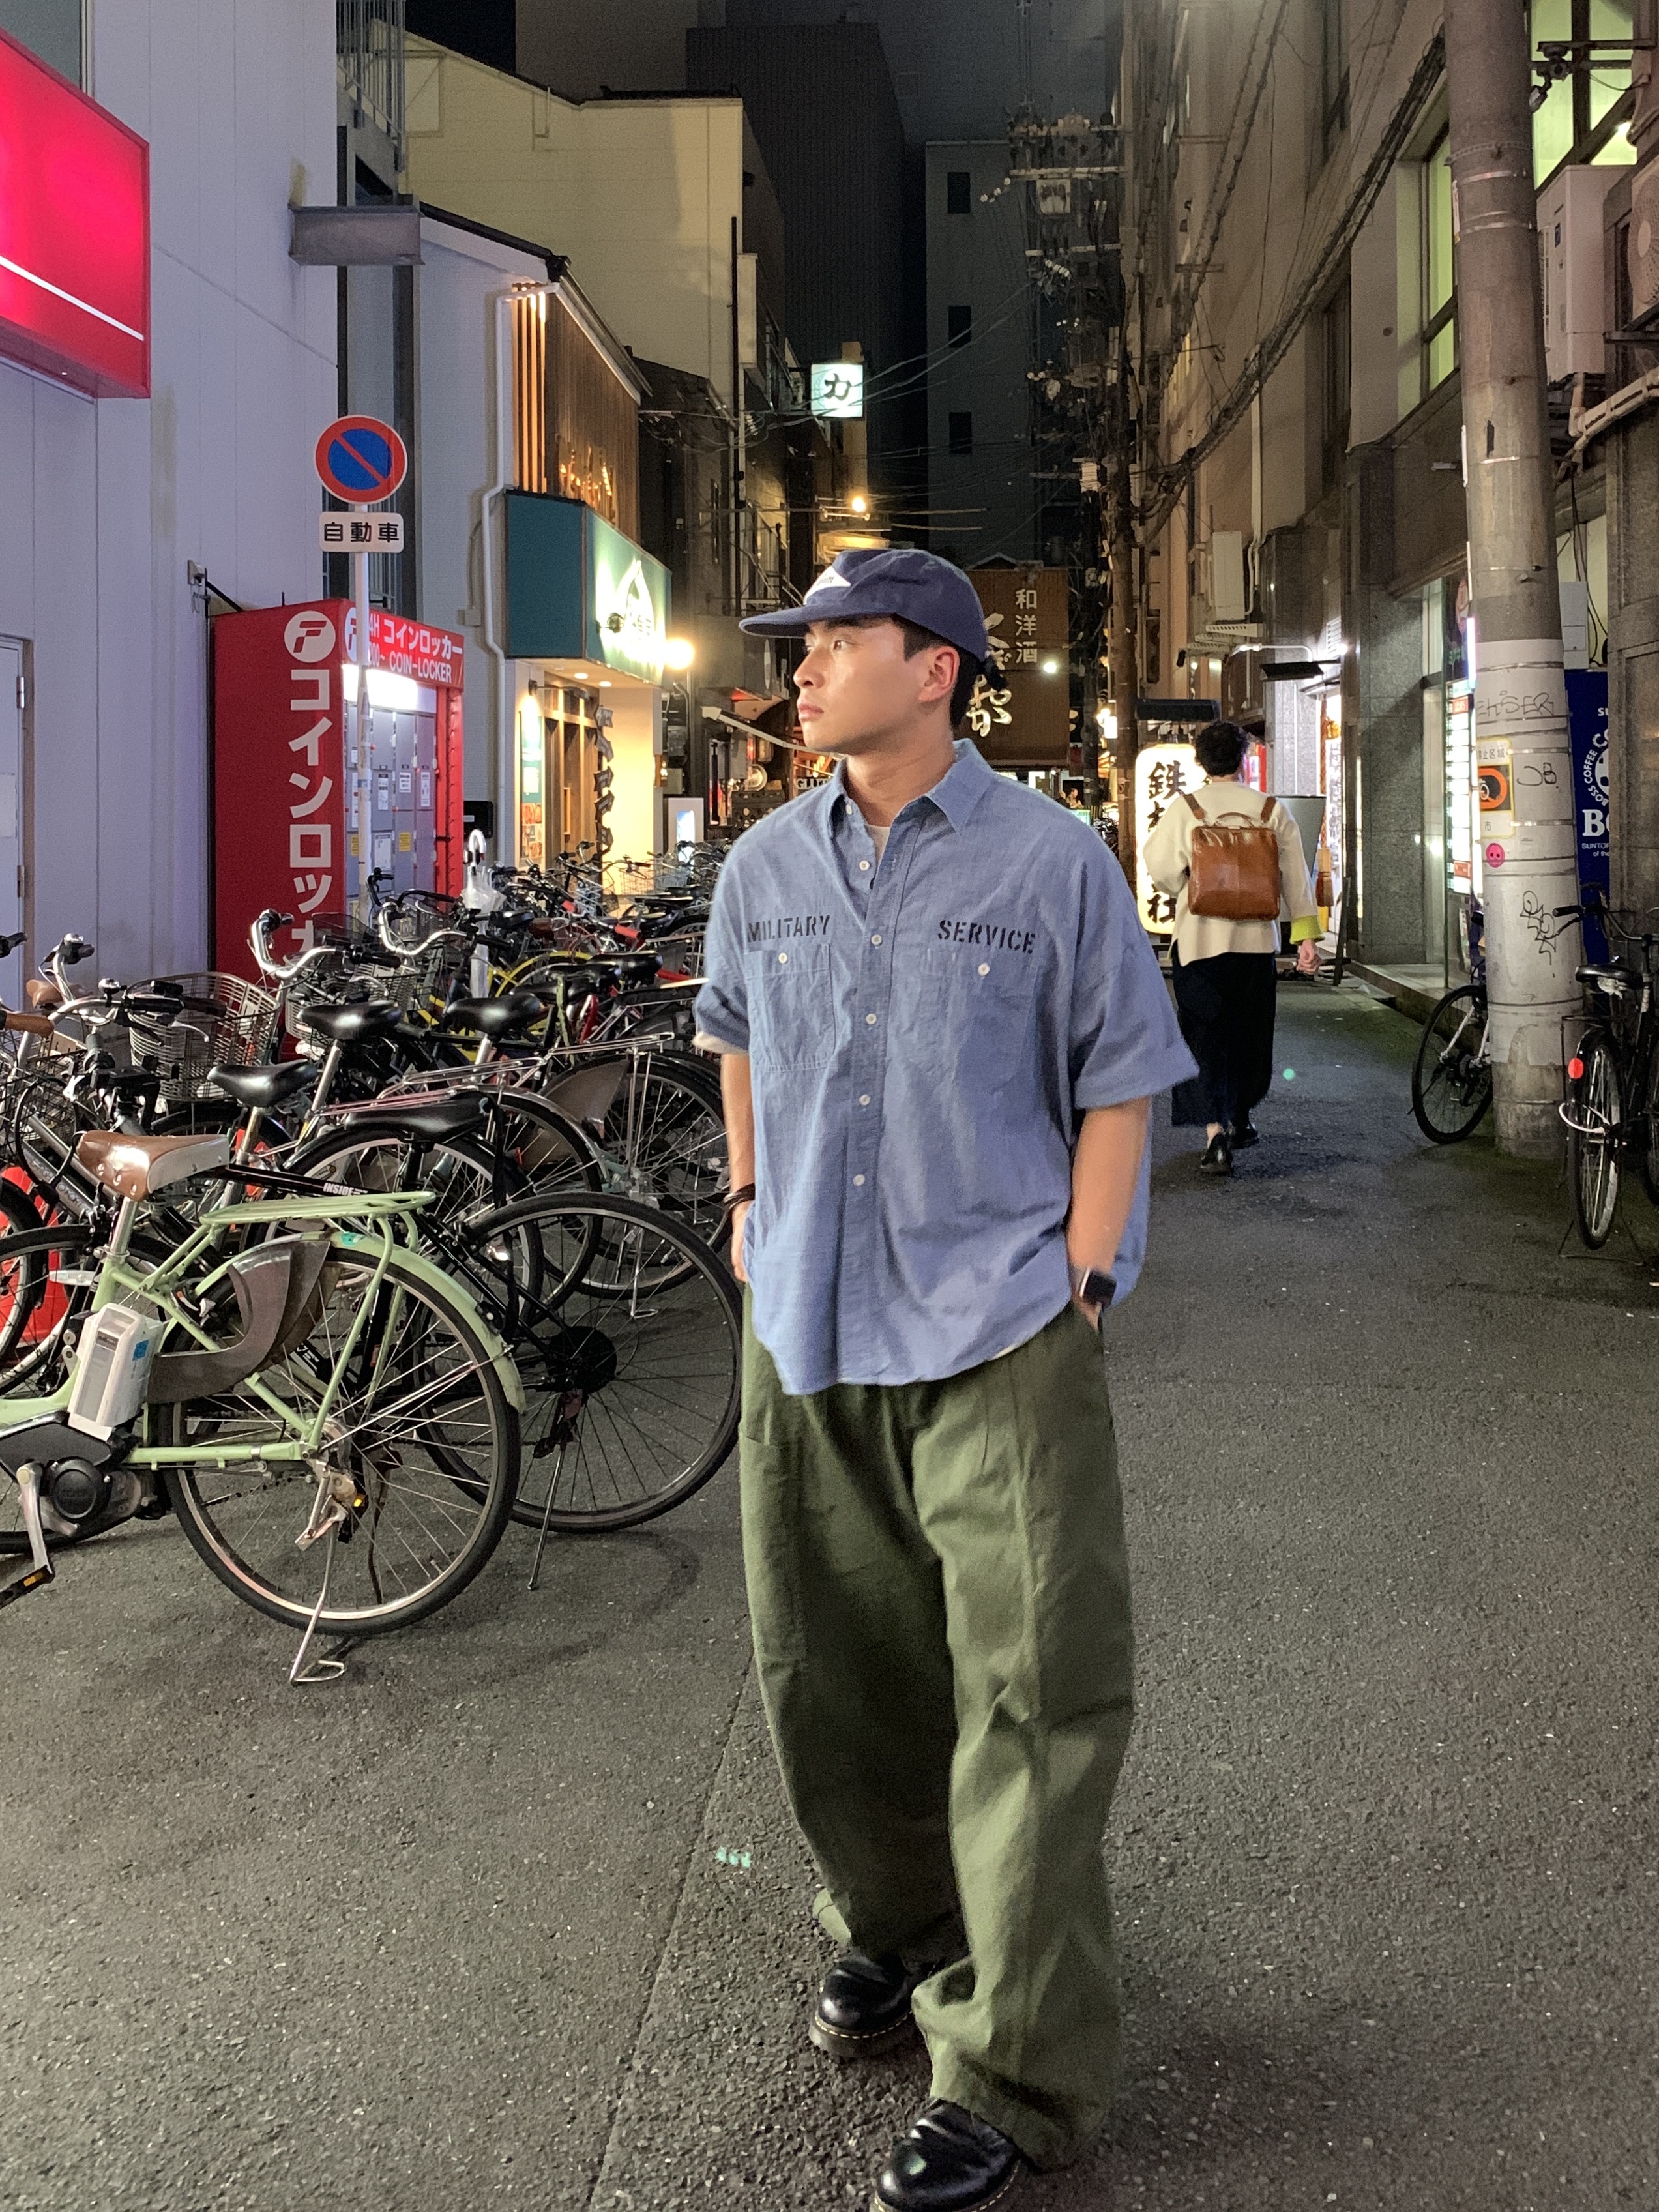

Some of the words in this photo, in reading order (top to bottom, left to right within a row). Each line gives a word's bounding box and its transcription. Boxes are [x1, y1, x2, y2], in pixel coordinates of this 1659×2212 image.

[324, 522, 399, 543] 自動車
[383, 619, 463, 660] コインロッカー
[1015, 588, 1037, 664] 和洋酒
[389, 650, 452, 683] COIN-LOCKER
[1583, 749, 1598, 784] COFFEE
[1582, 809, 1609, 836] B
[746, 915, 830, 943] MILITARY
[937, 919, 1036, 954] SERVICE
